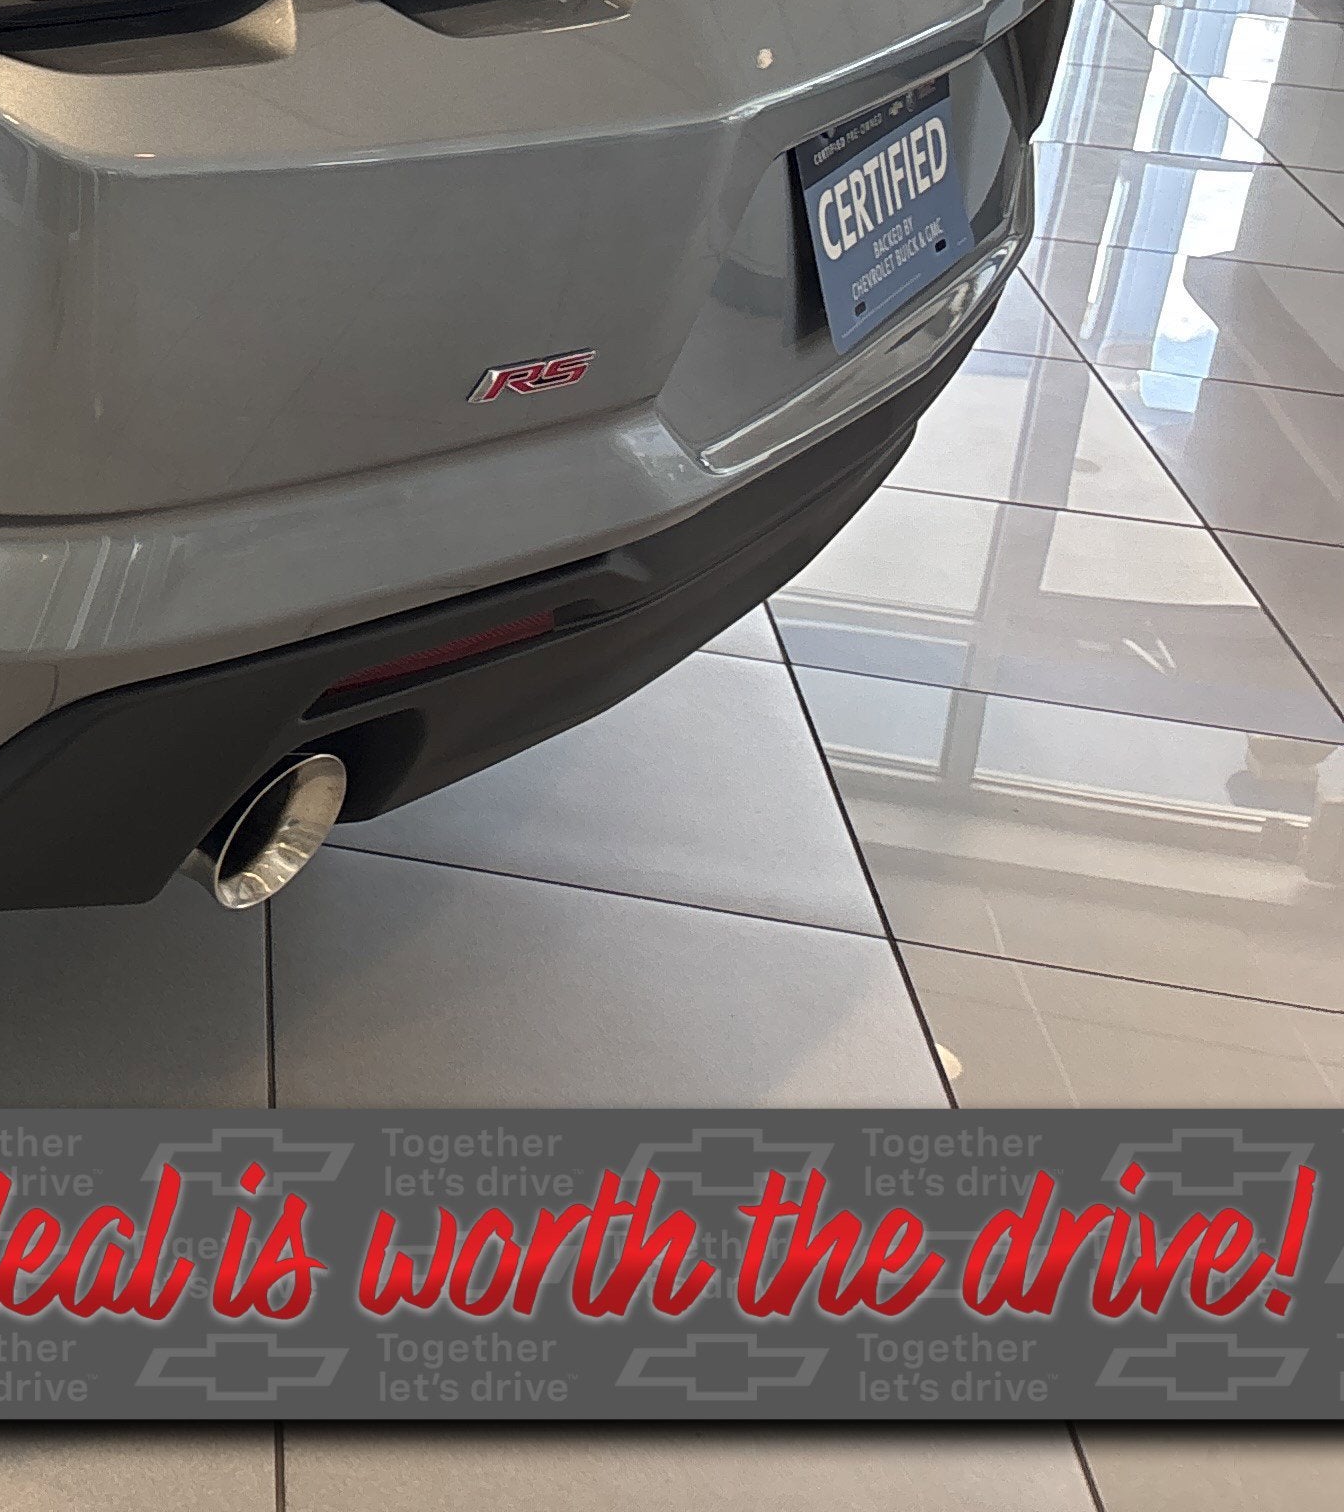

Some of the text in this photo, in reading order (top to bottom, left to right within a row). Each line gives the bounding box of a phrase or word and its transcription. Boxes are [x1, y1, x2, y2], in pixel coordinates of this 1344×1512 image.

[818, 117, 948, 261] CERTIFIED
[852, 217, 944, 301] CHEVROLET BUICK & GMC
[873, 216, 913, 259] BACKED BY
[466, 348, 597, 404] RS
